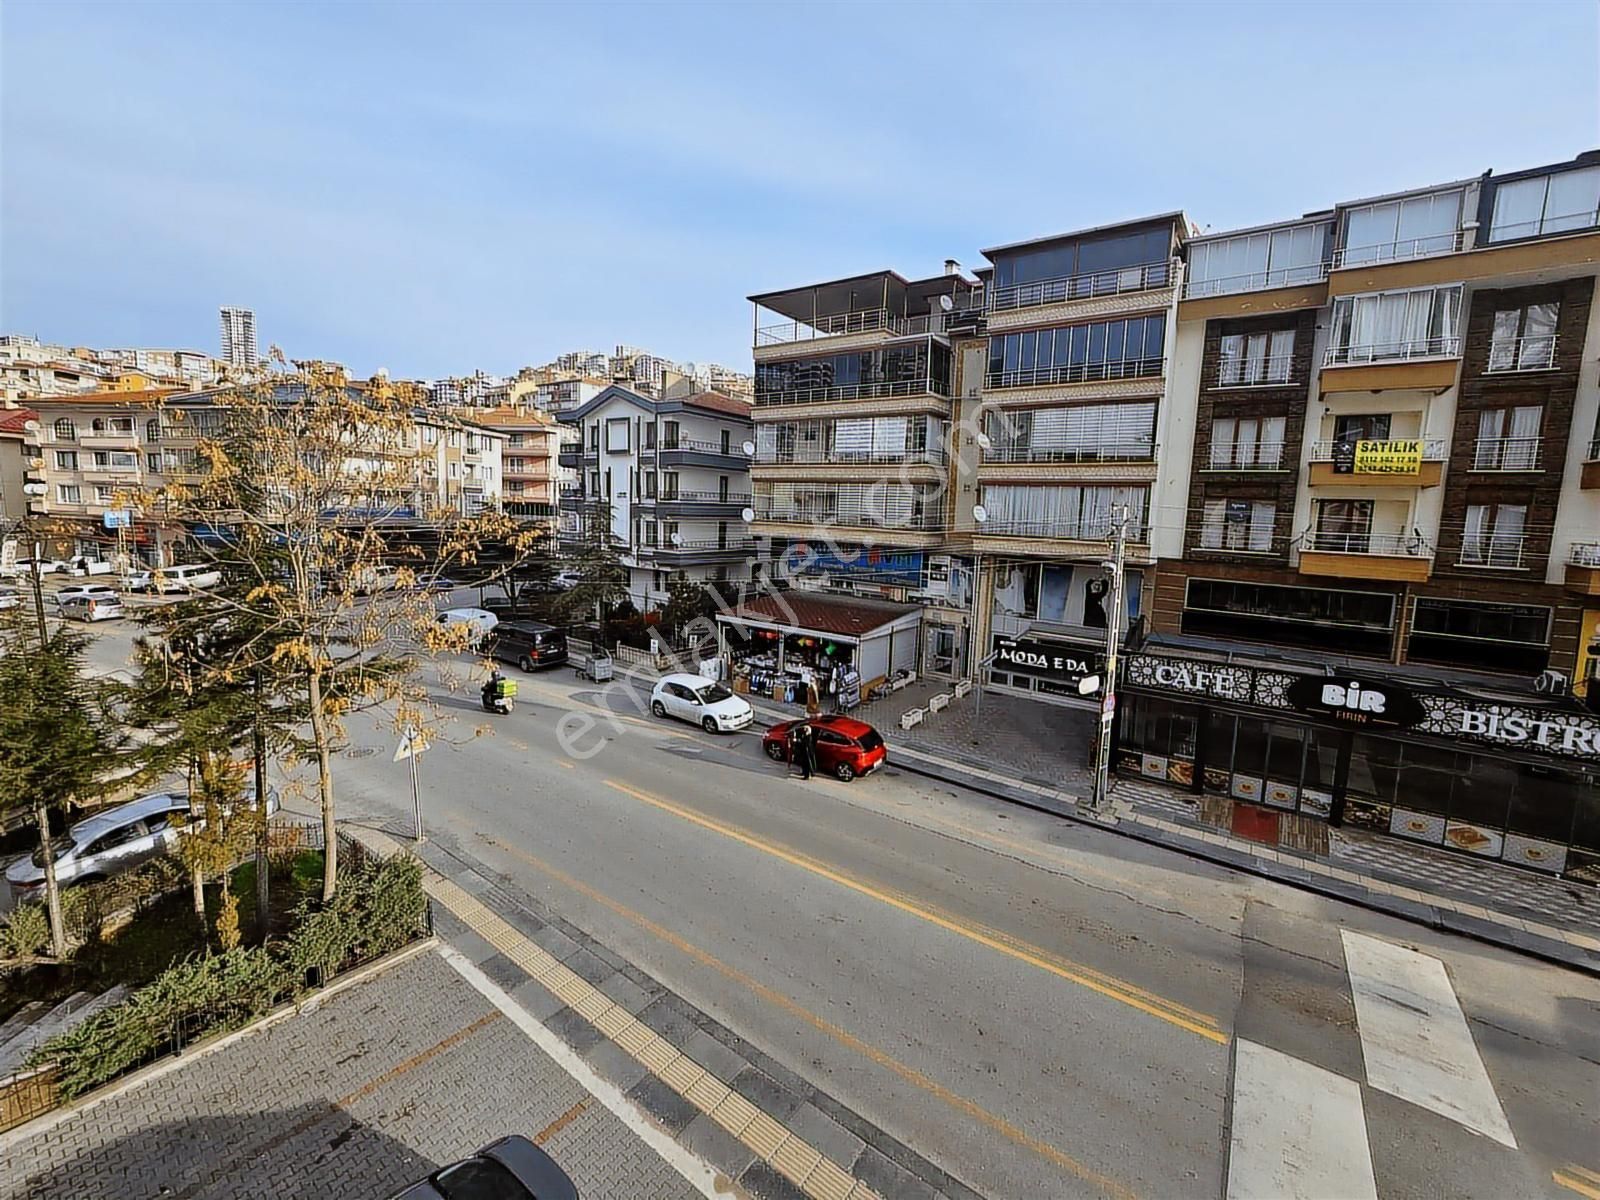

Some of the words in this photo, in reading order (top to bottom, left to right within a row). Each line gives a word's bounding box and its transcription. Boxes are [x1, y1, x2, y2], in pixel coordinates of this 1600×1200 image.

[1361, 441, 1418, 453] SATILIK
[1000, 648, 1048, 667] MODA
[1054, 657, 1089, 673] EDA
[1155, 665, 1234, 694] CAFE
